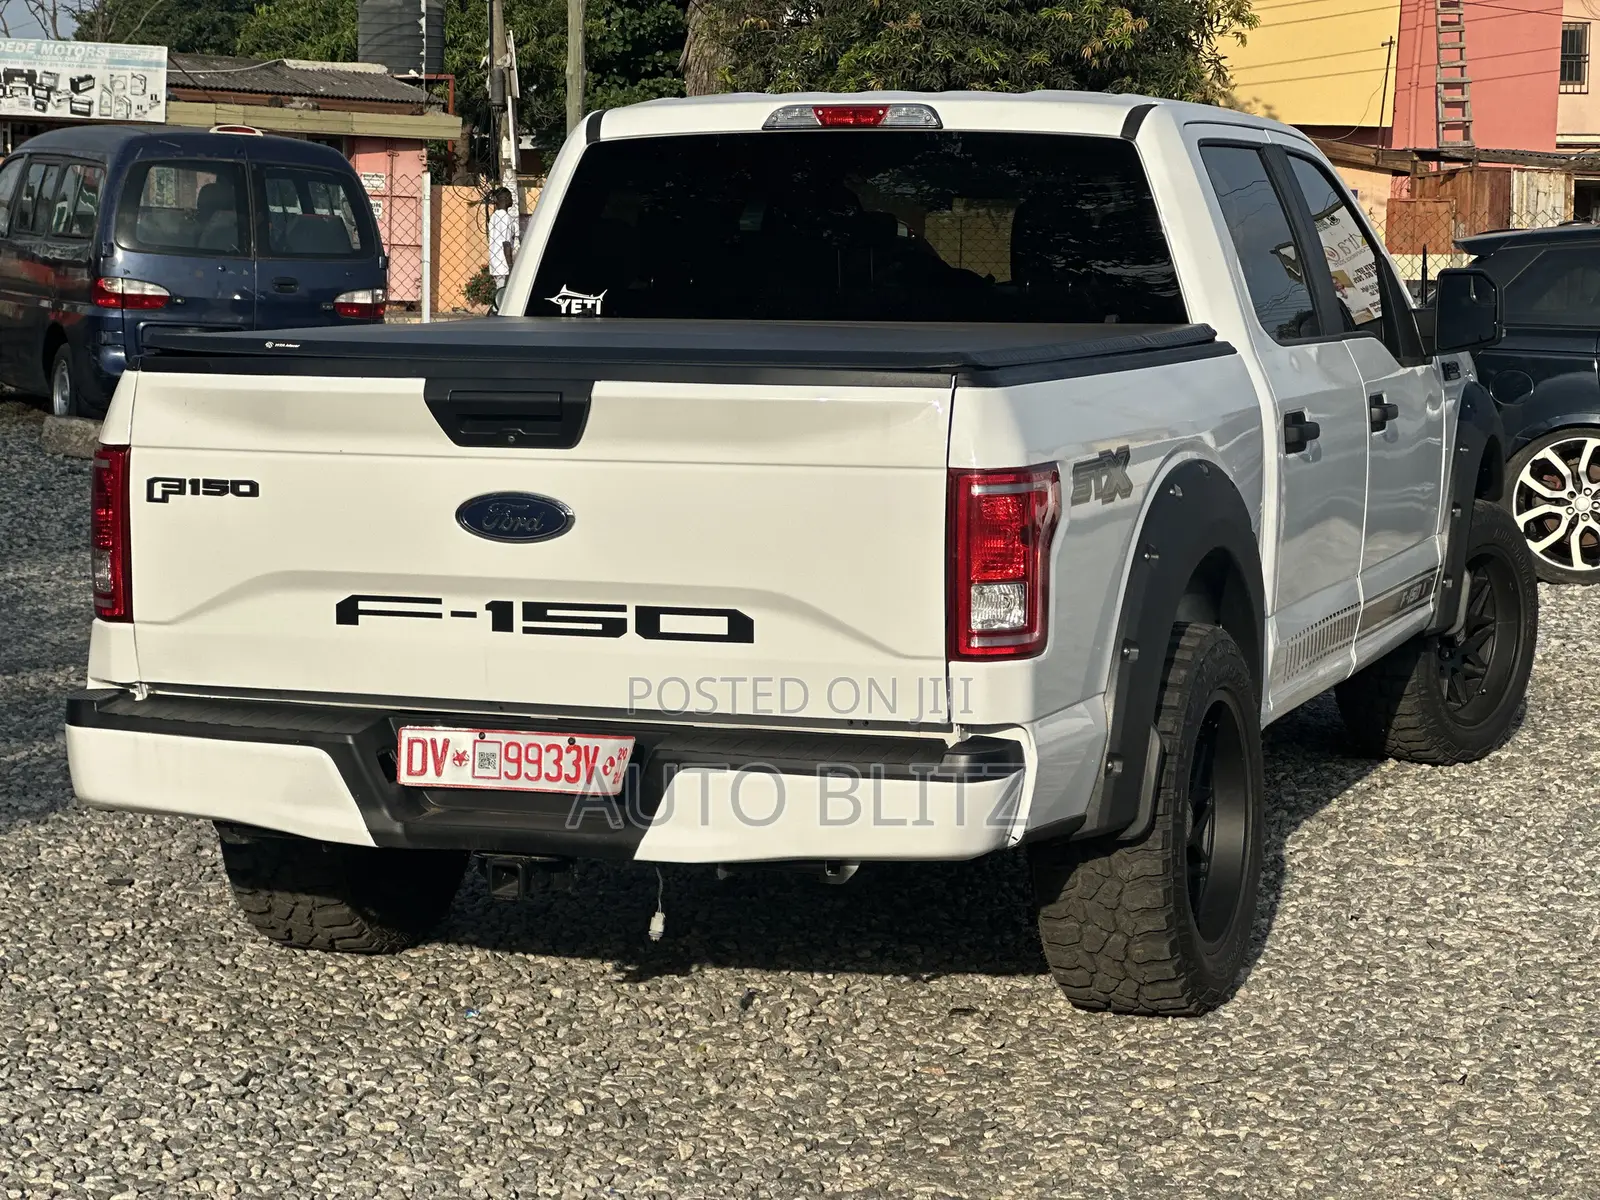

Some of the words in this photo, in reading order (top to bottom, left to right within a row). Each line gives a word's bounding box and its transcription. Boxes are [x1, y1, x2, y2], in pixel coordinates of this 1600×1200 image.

[40, 43, 105, 58] MOTORS
[558, 299, 601, 315] YETI
[1071, 444, 1134, 507] STX
[482, 502, 545, 532] Ford
[336, 595, 754, 644] F-150
[406, 737, 450, 777] DV
[503, 741, 600, 785] 9933V
